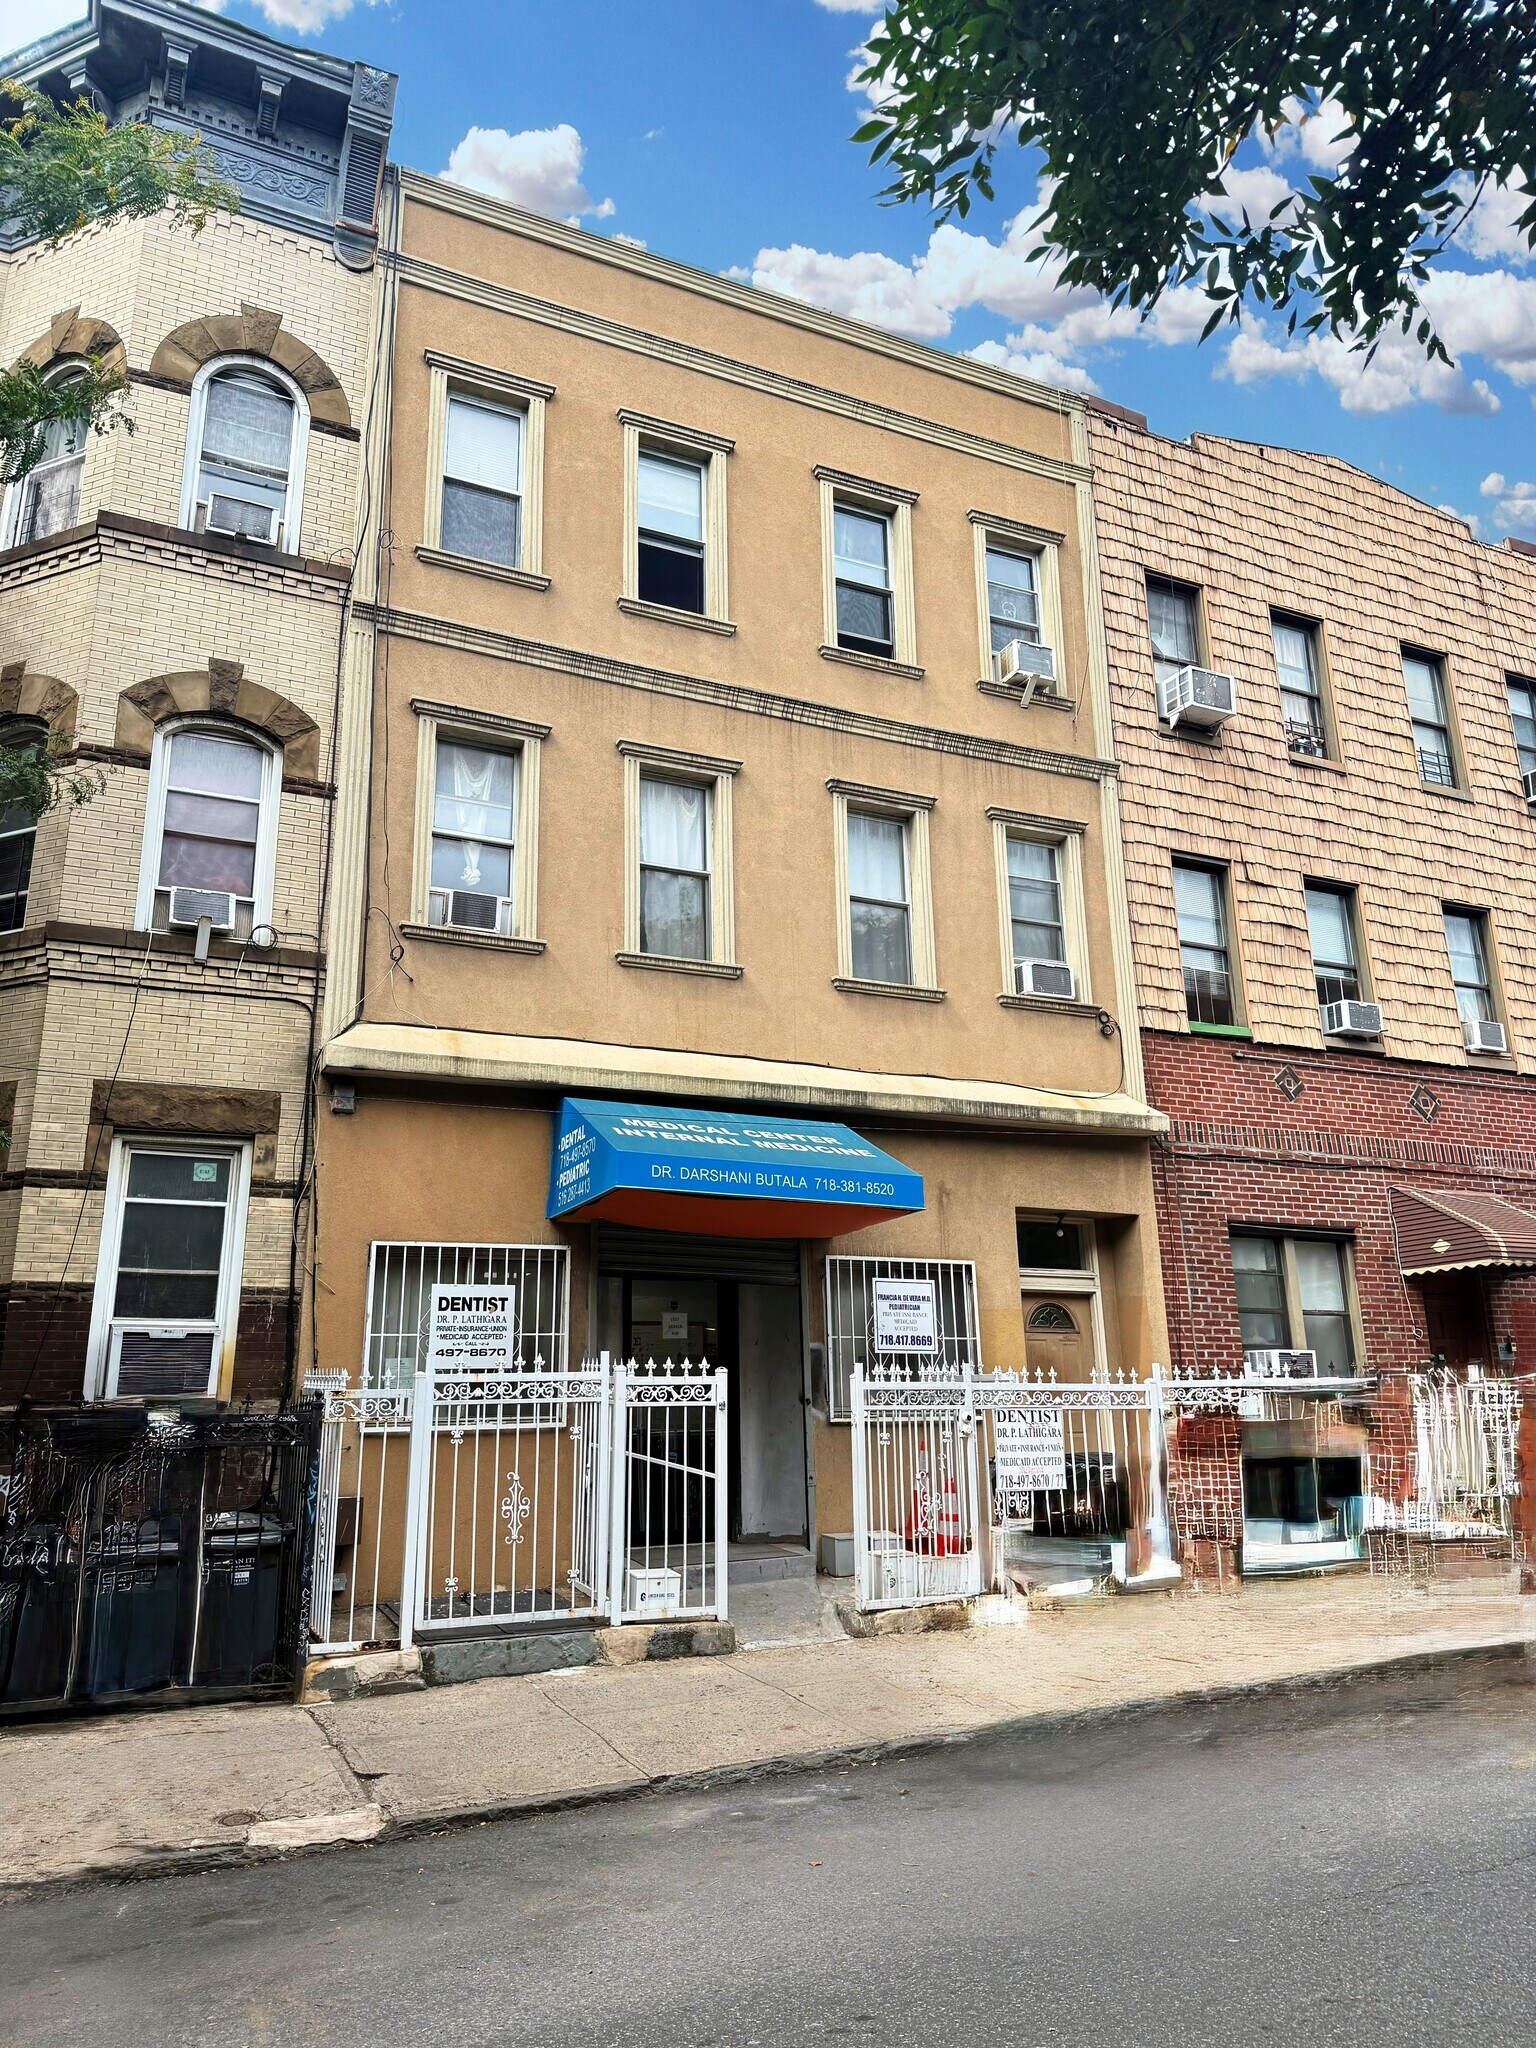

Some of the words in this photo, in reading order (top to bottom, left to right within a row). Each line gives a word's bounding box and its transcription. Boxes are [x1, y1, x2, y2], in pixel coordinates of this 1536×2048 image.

[560, 1124, 586, 1152] DENTAL
[620, 1117, 739, 1136] MEDICAL
[742, 1129, 843, 1146] CENTER
[612, 1127, 750, 1147] INTERNAL
[751, 1140, 877, 1158] MEDICINE
[559, 1159, 590, 1188] PEDIATRIC
[651, 1164, 676, 1179] DR.
[680, 1167, 752, 1184] DARSHANI
[756, 1173, 808, 1189] BUTALA
[814, 1178, 894, 1196] 718-381-8520
[438, 1296, 509, 1312] DENTIST
[877, 1293, 897, 1301] FRANCIA
[888, 1303, 921, 1311] PEDIATRICIAN
[437, 1315, 450, 1324] DR.
[452, 1315, 459, 1324] P.
[461, 1315, 507, 1324] LATHIGARA
[879, 1334, 932, 1346] 718.417.8669
[435, 1348, 507, 1357] 497-8670
[997, 1409, 1060, 1423] DENTIST
[997, 1428, 1010, 1438] DR.
[1011, 1428, 1017, 1438] P.
[1018, 1428, 1062, 1438] LATHIGARA
[1000, 1457, 1031, 1466] MEDICAID
[1032, 1456, 1062, 1466] ACCEPTED
[1000, 1474, 1050, 1488] 718-497-8670
